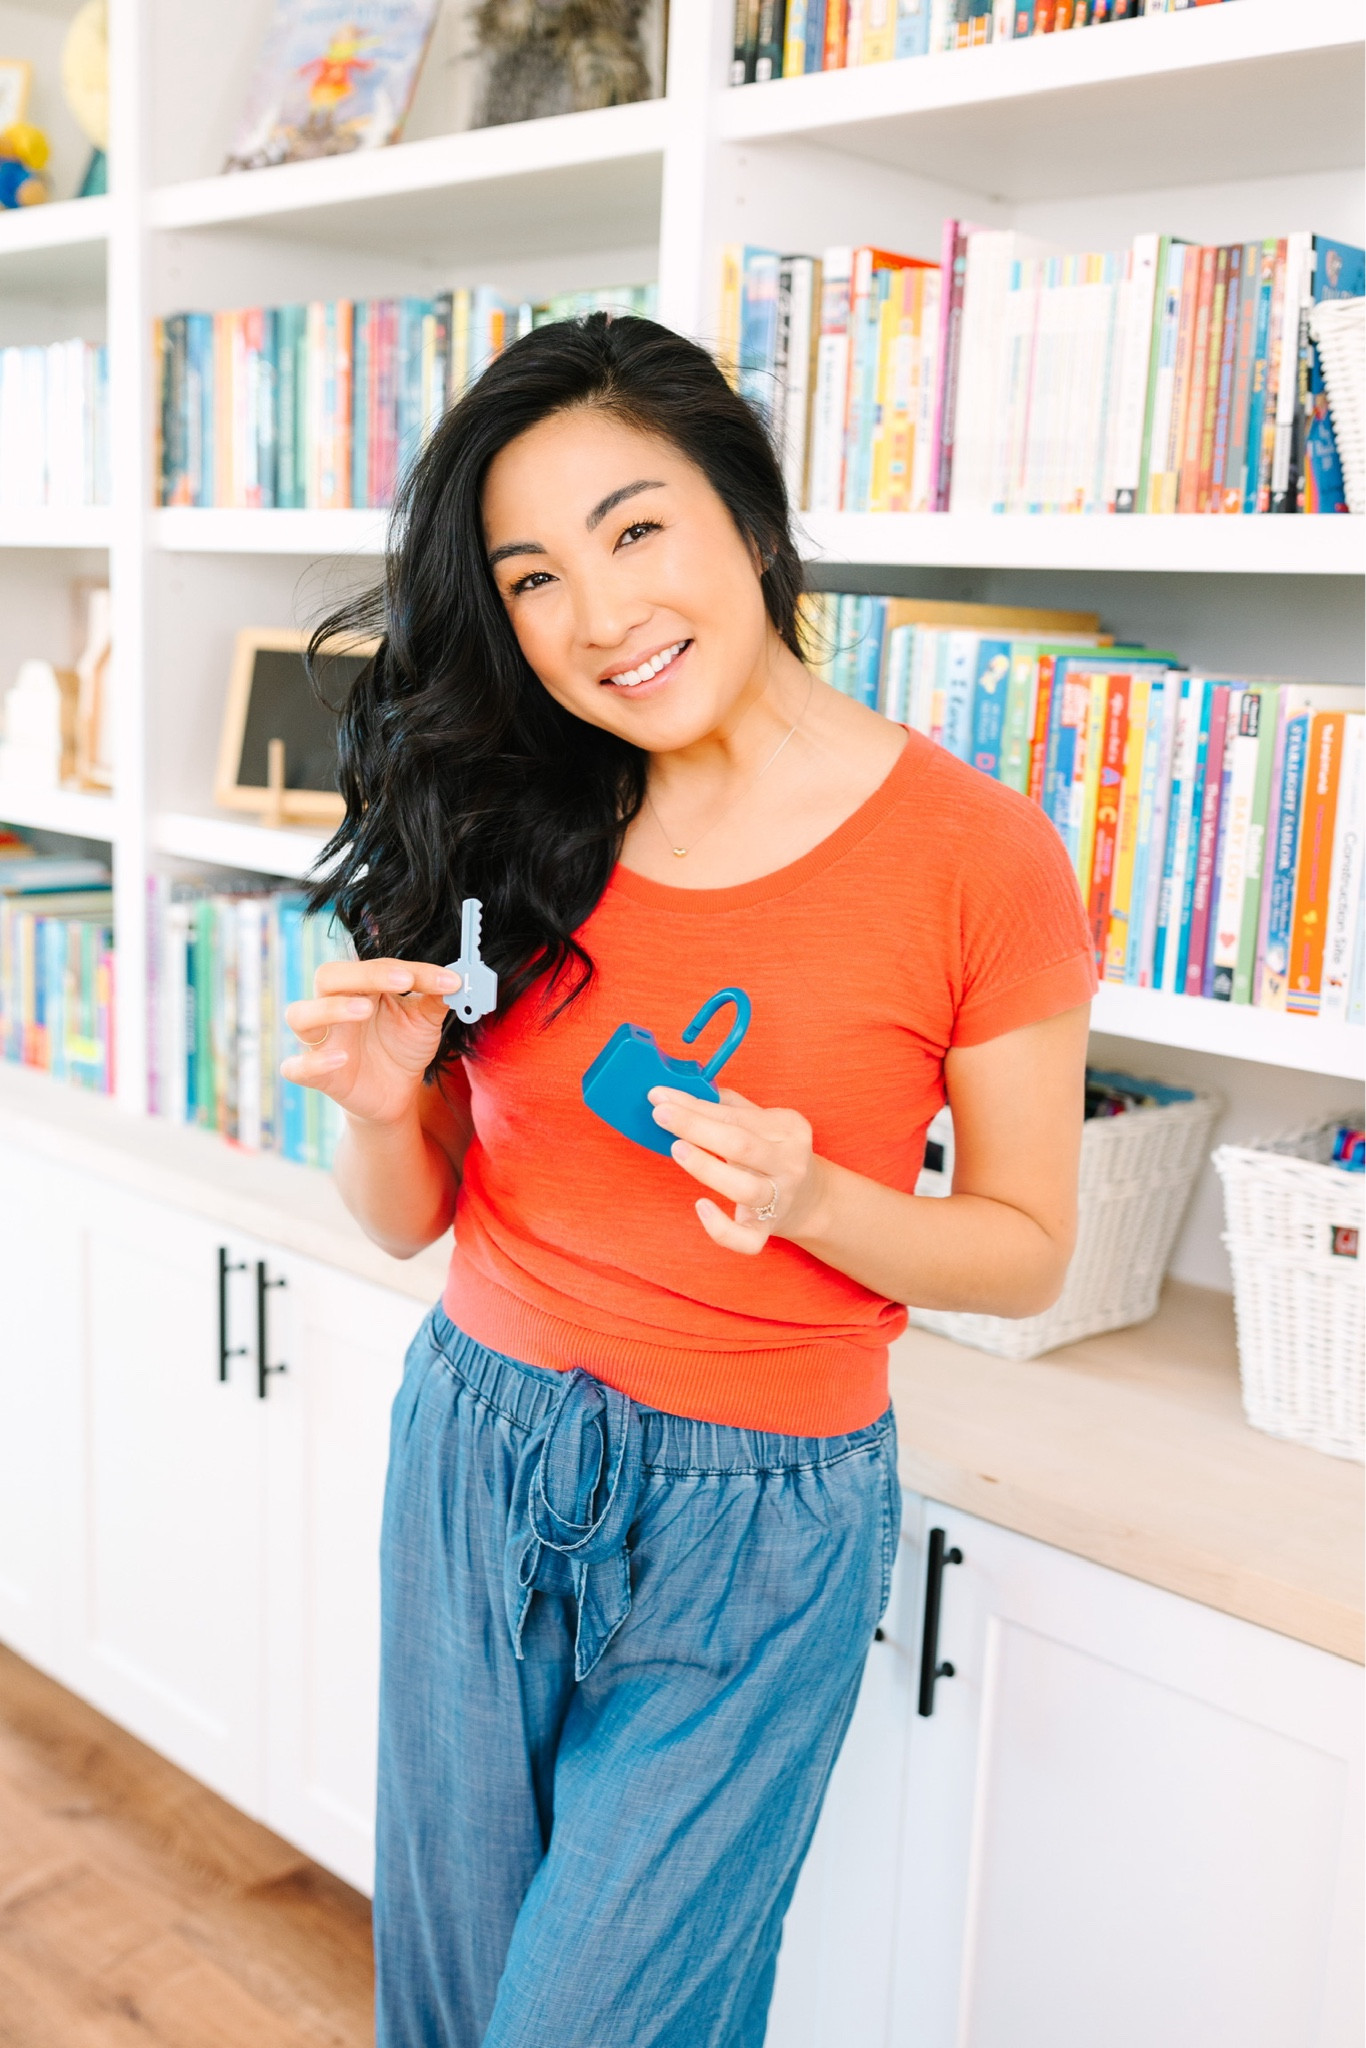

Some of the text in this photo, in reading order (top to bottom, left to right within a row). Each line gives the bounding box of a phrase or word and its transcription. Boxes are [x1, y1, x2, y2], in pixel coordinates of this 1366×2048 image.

[1098, 766, 1120, 823] ABC
[1279, 726, 1303, 870] STARLIGHT SAILOR
[1194, 783, 1219, 912] That's When I'm Happy
[1226, 796, 1248, 902] BABY LOVE
[1332, 831, 1358, 934] Construction
[1331, 936, 1348, 966] Site
